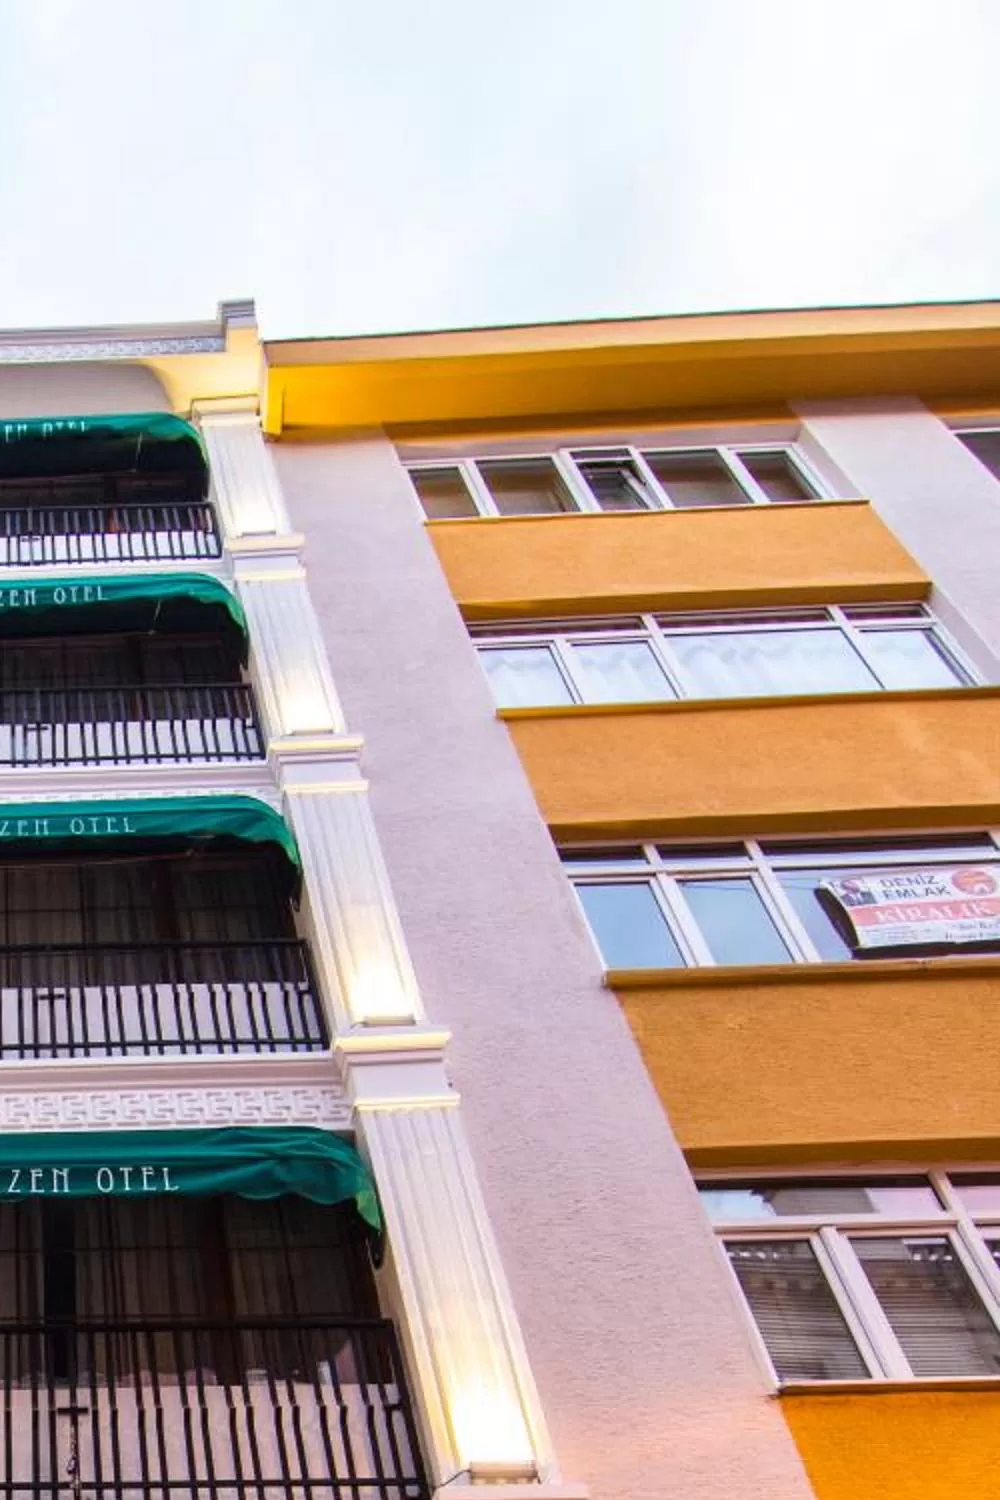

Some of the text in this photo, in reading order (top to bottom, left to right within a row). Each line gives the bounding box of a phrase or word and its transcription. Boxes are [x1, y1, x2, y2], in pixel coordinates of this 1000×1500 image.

[53, 585, 109, 605] OTEL
[69, 816, 137, 835] OTEL
[881, 886, 952, 901] EMLAK
[96, 1166, 180, 1193] OTEL
